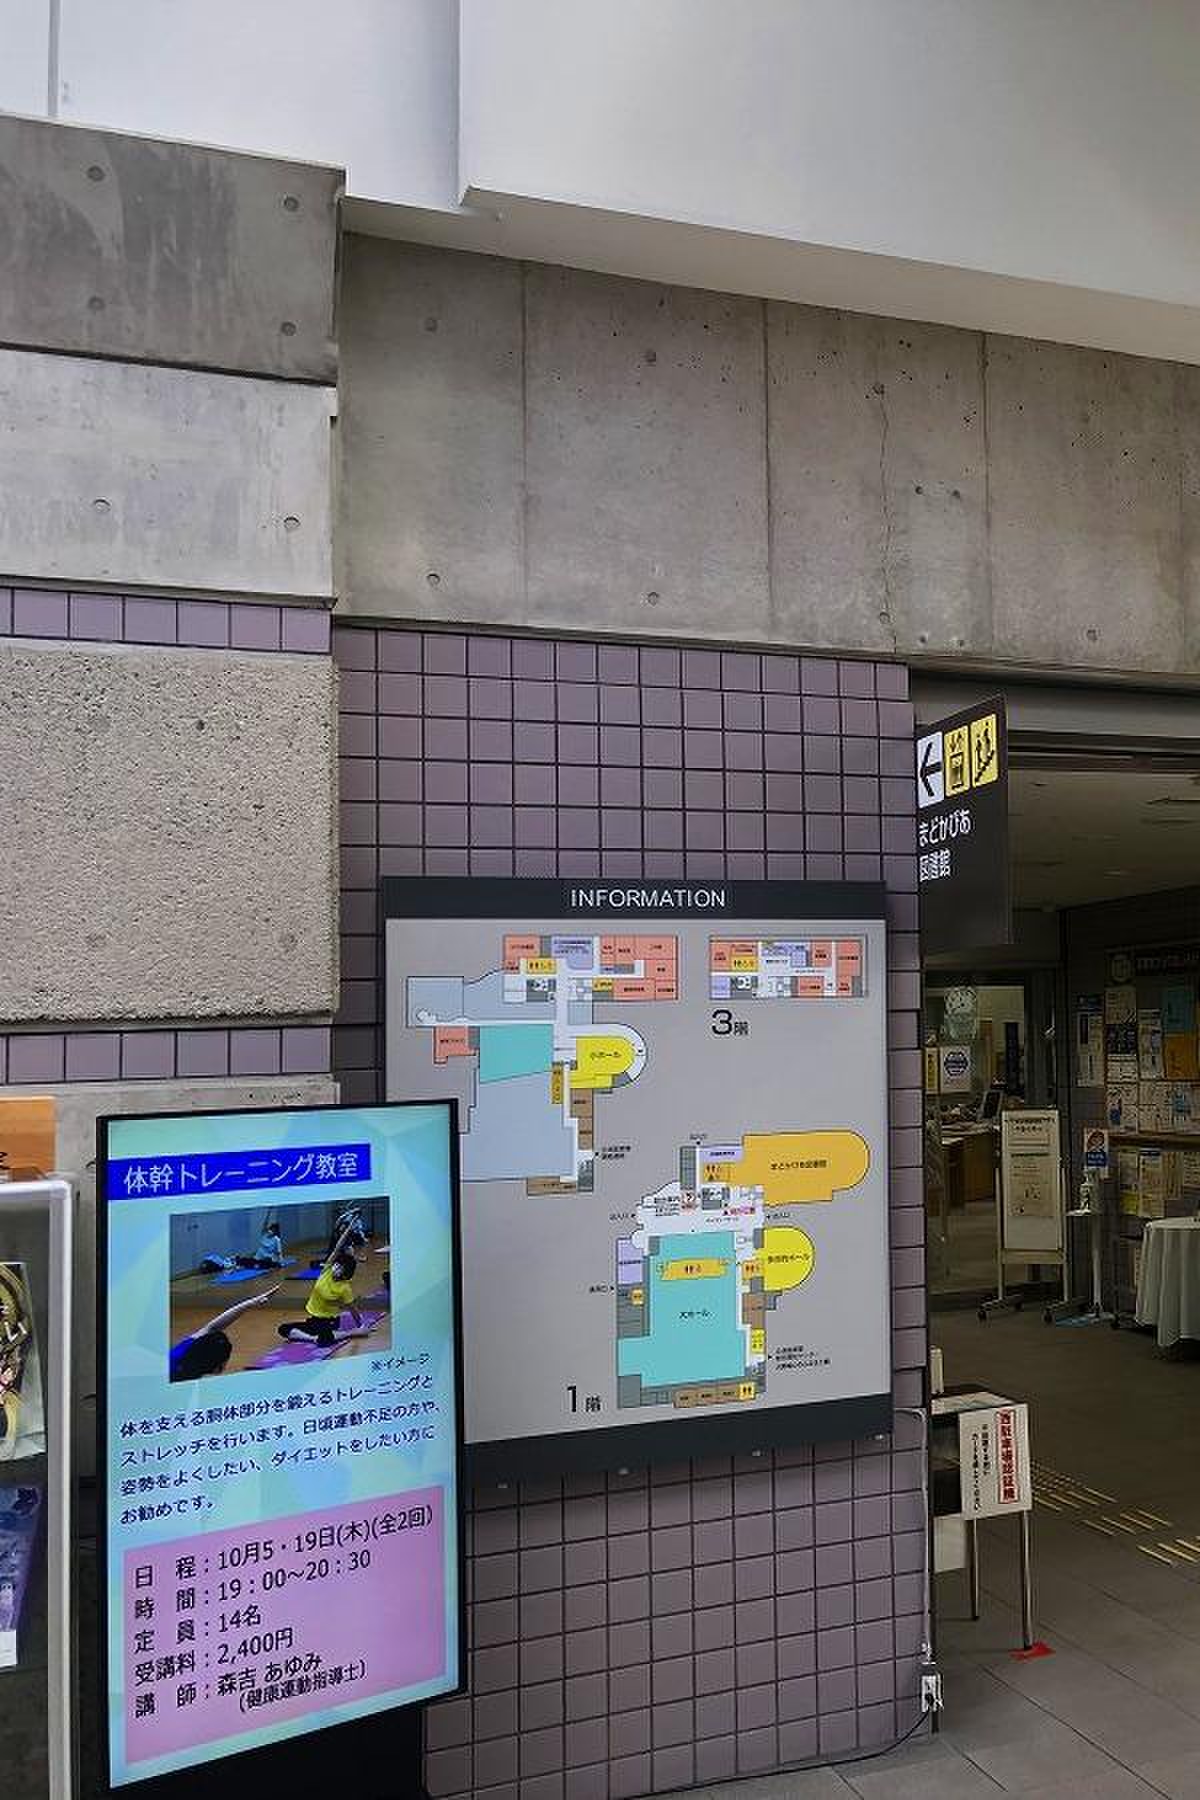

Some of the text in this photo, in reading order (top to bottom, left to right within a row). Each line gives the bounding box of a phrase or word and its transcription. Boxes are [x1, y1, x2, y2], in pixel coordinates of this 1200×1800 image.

[919, 808, 970, 847] まどかぴあ
[571, 889, 726, 908] INFORMATION
[711, 1009, 749, 1036] 3階
[123, 1151, 359, 1195] 体幹トレーニング教室
[120, 1494, 214, 1526] お勧めです。
